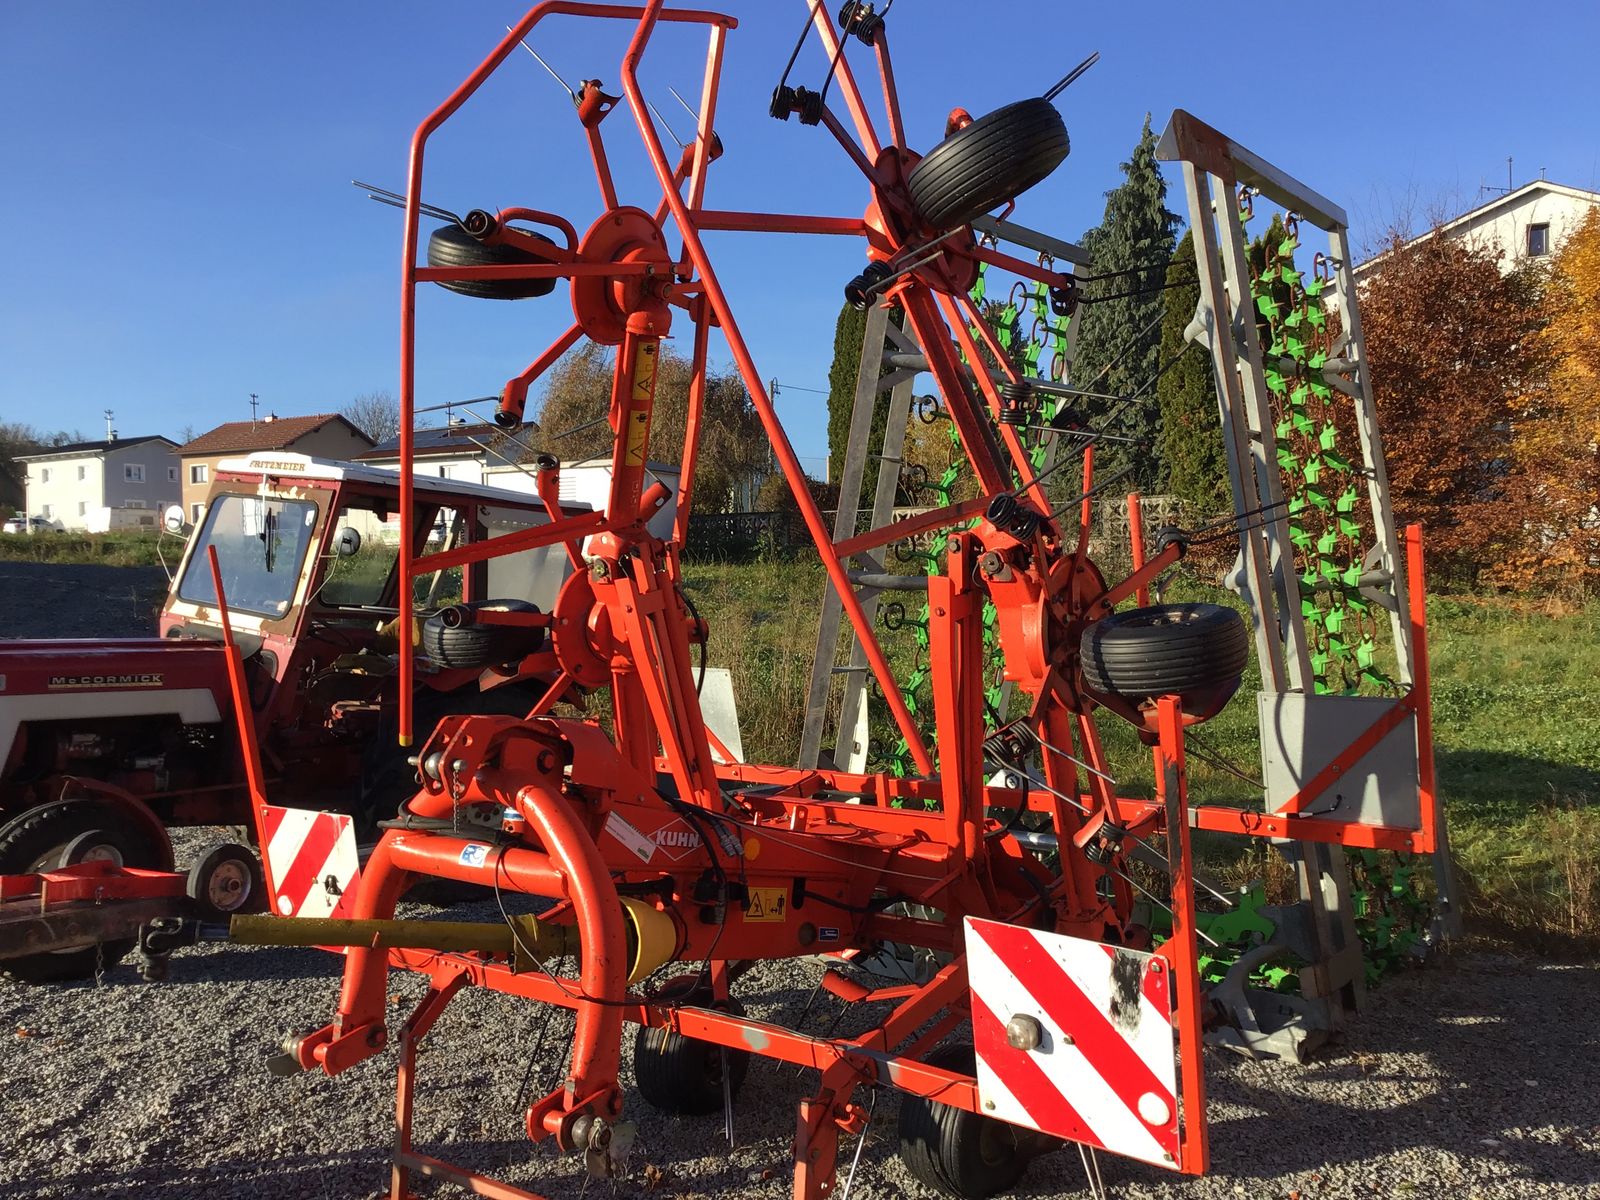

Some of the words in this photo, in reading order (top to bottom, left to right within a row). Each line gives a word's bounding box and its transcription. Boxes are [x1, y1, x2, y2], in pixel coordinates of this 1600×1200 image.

[249, 460, 306, 471] FRITZMEIER
[51, 675, 161, 685] McCORMICK
[655, 830, 699, 848] KUHN
